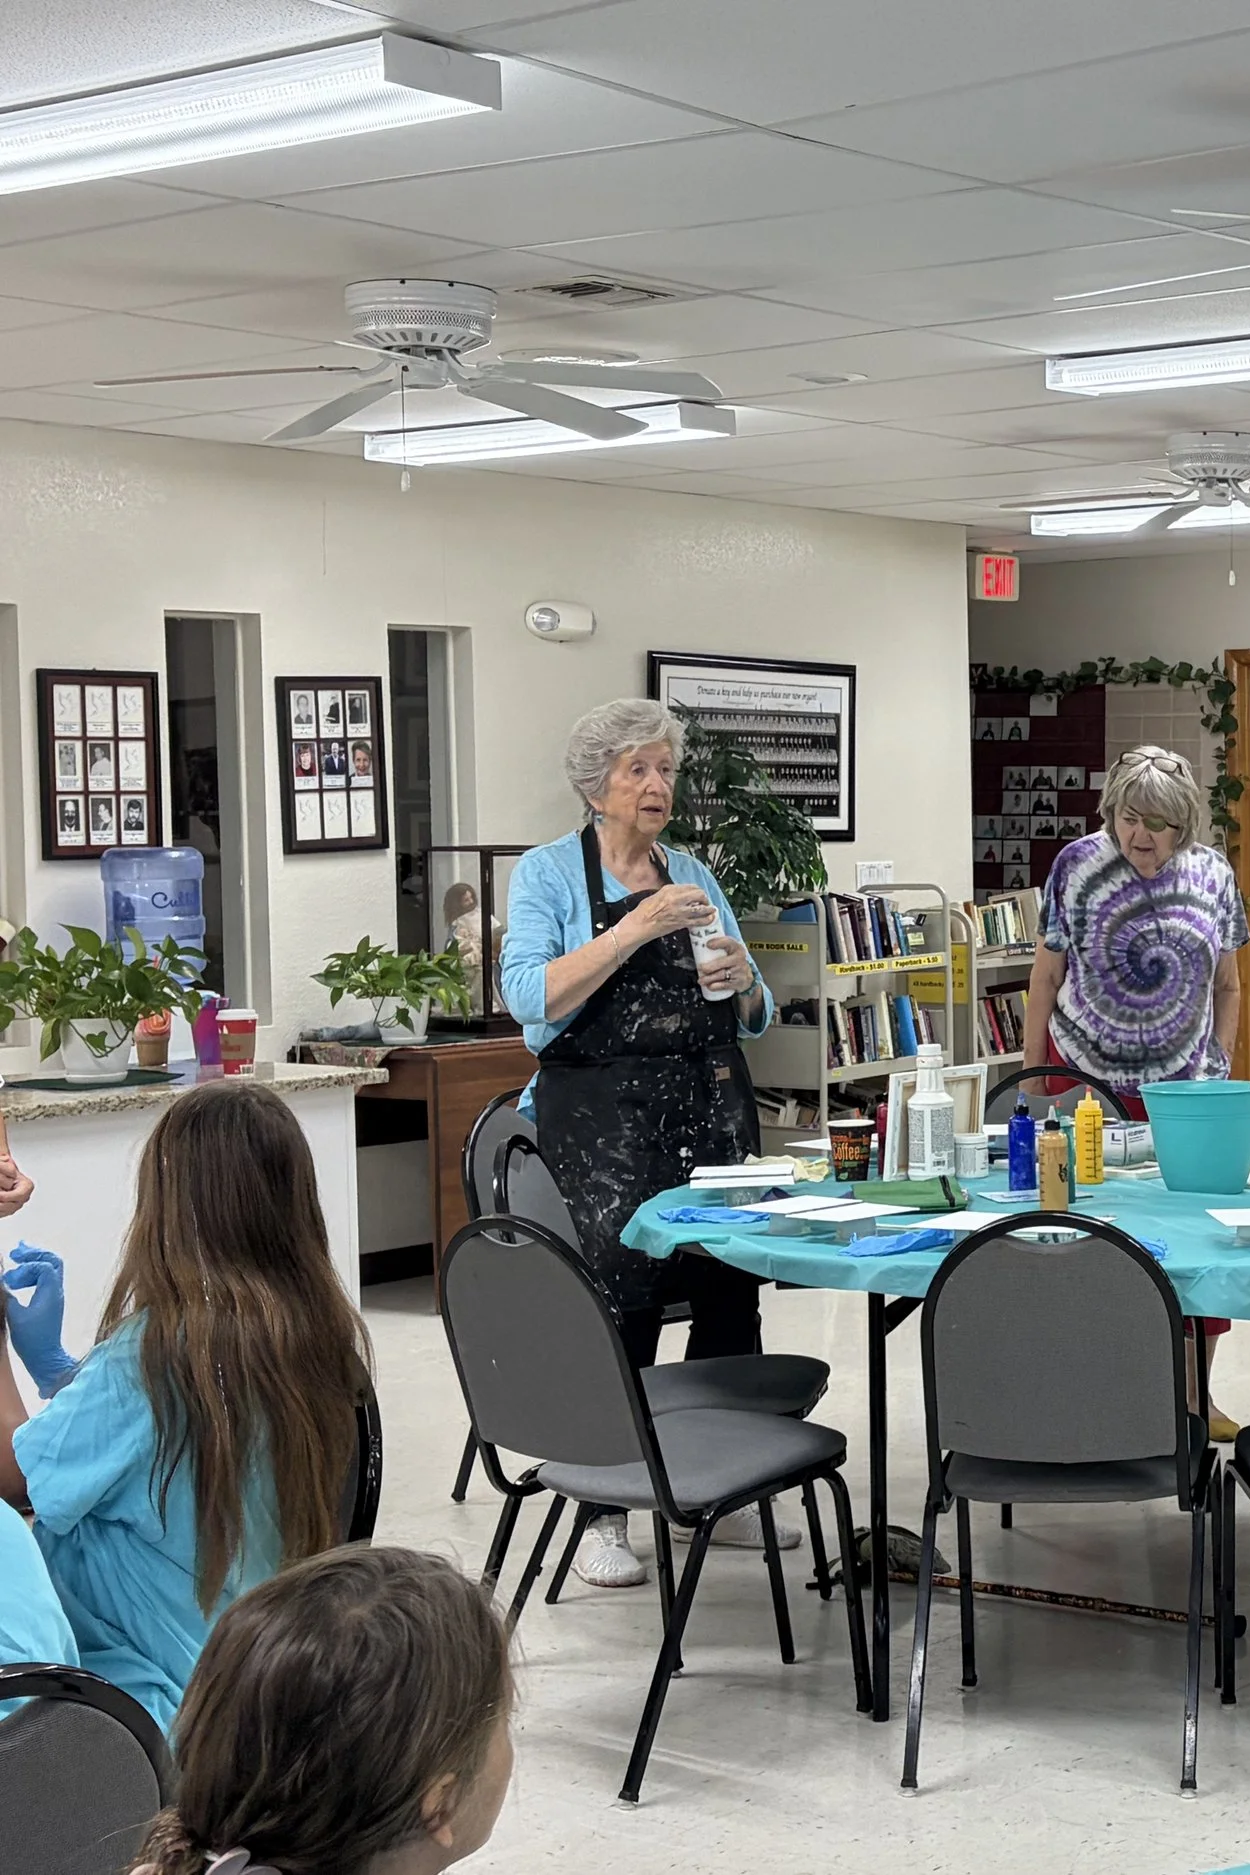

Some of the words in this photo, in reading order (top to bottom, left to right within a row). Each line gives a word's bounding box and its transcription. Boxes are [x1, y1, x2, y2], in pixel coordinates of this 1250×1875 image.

[984, 557, 1015, 597] EXIT
[731, 686, 742, 698] and
[760, 687, 781, 702] purchase
[766, 942, 785, 951] BOOK
[786, 943, 804, 952] SALE
[839, 964, 865, 974] Hardback
[869, 962, 885, 971] $1.00
[895, 957, 922, 968] Paperback
[832, 1142, 860, 1162] Coffee
